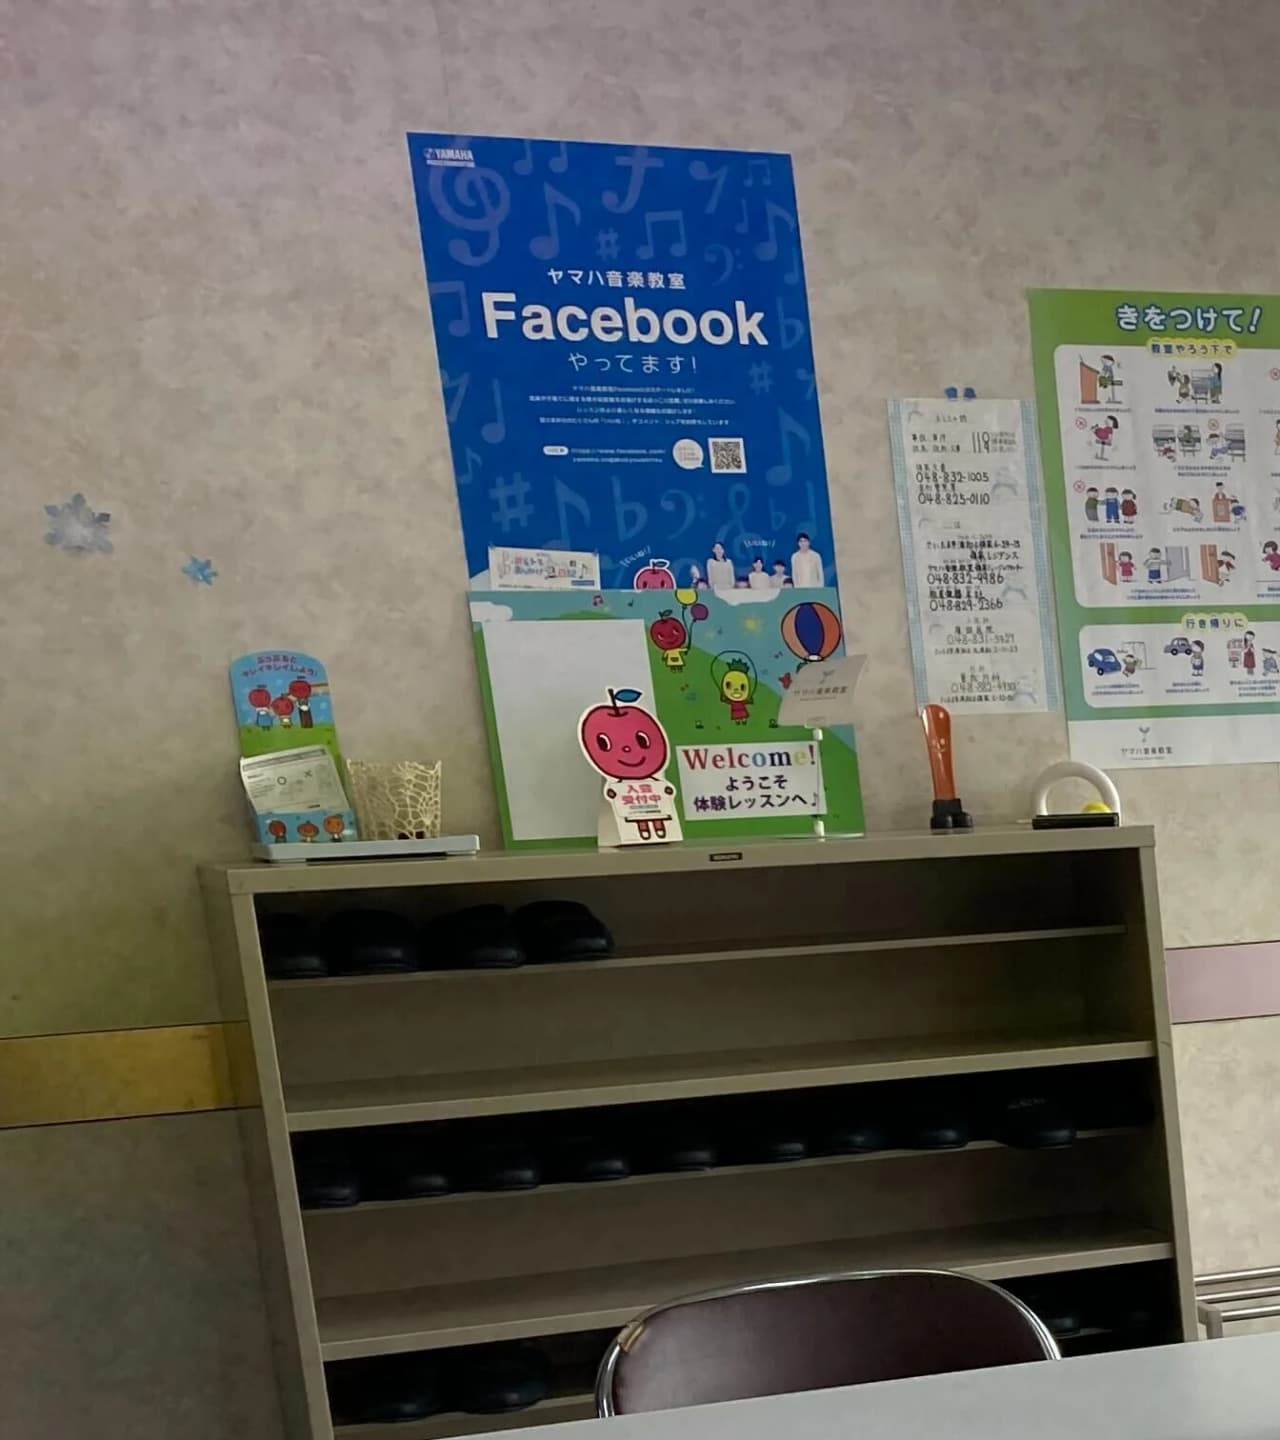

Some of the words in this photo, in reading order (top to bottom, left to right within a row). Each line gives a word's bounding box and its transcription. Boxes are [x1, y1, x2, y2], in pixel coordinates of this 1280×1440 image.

[435, 148, 474, 161] YAMAHA
[547, 268, 686, 290] ヤマハ音楽教室
[481, 291, 769, 346] Facebook
[1116, 304, 1262, 332] きをつけて!
[568, 352, 697, 375] やってます!
[1185, 617, 1244, 630] 行き帰りに
[681, 743, 816, 770] Welcome!
[626, 783, 653, 794] 入会
[724, 773, 788, 792] ようこそ
[621, 793, 661, 806] 受付中
